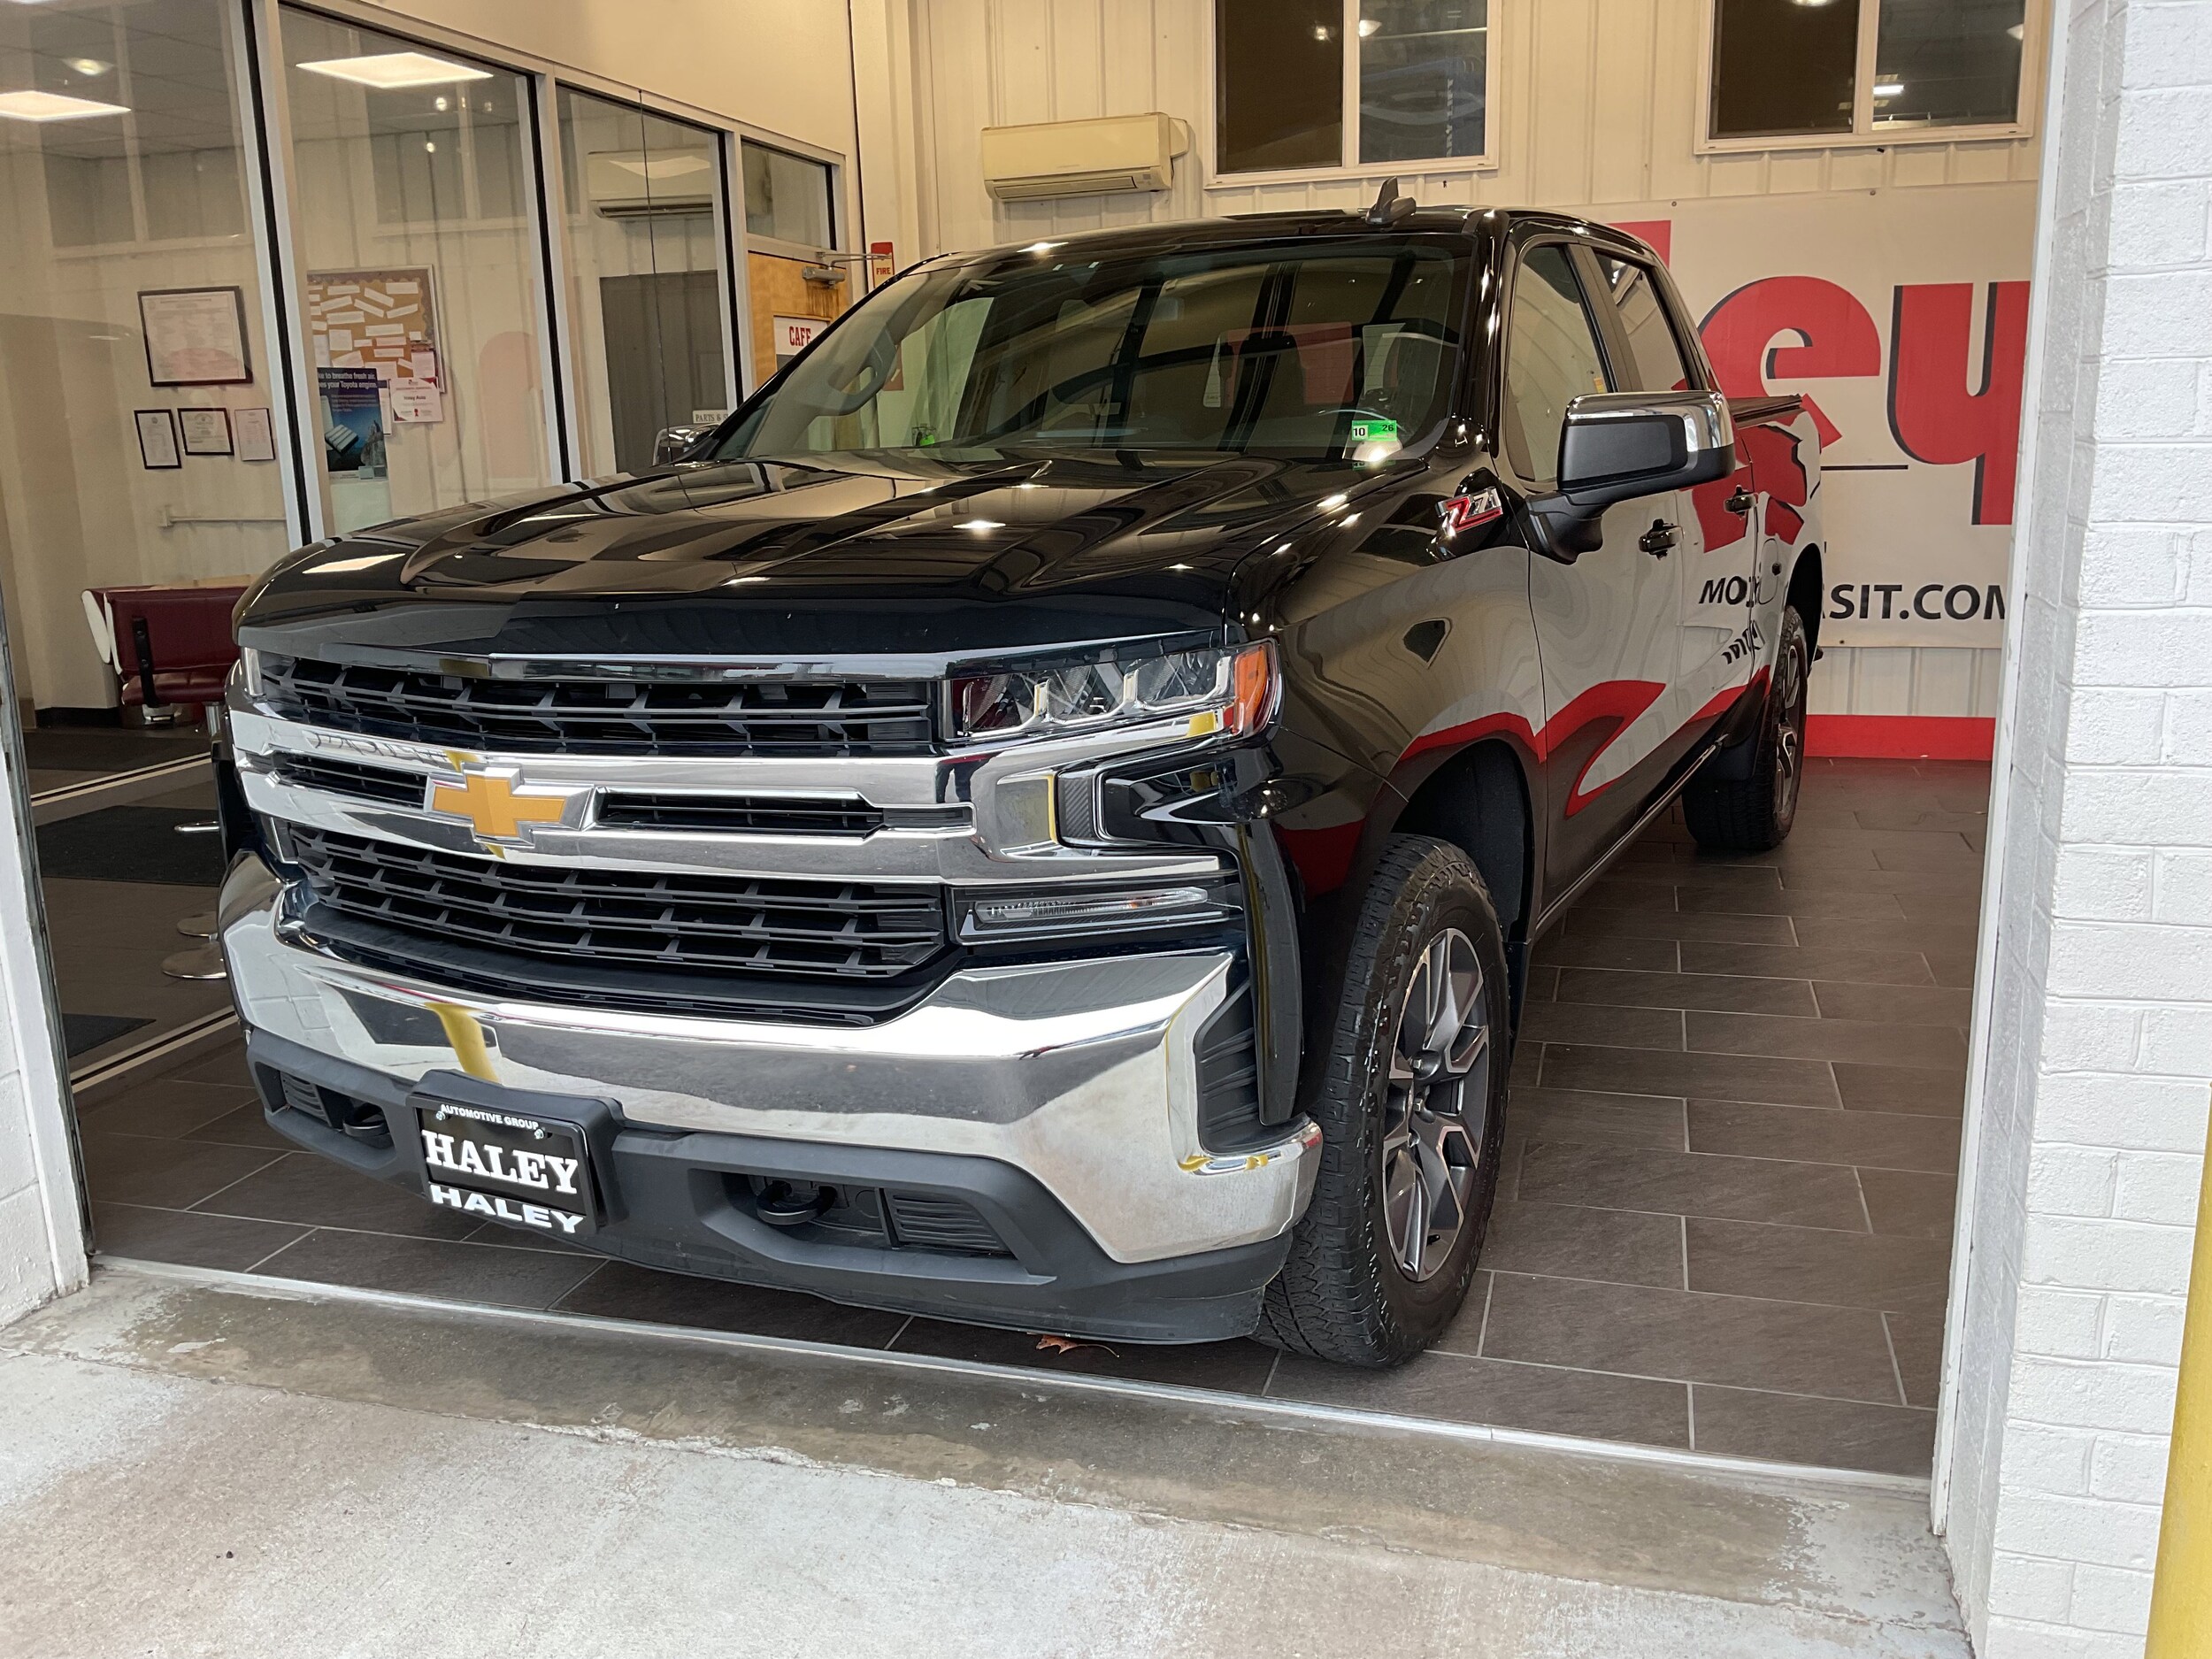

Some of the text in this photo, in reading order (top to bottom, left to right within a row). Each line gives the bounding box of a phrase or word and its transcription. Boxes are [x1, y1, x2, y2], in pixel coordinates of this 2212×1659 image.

[789, 326, 811, 346] CAFE
[340, 380, 357, 389] Toyota
[695, 413, 715, 422] PARTS
[1353, 427, 1365, 436] 10
[1435, 487, 1503, 534] Z71
[441, 1104, 539, 1130] AUTOMOTIVE GROUP
[421, 1129, 579, 1194] HALEY
[430, 1184, 584, 1233] HALEY
